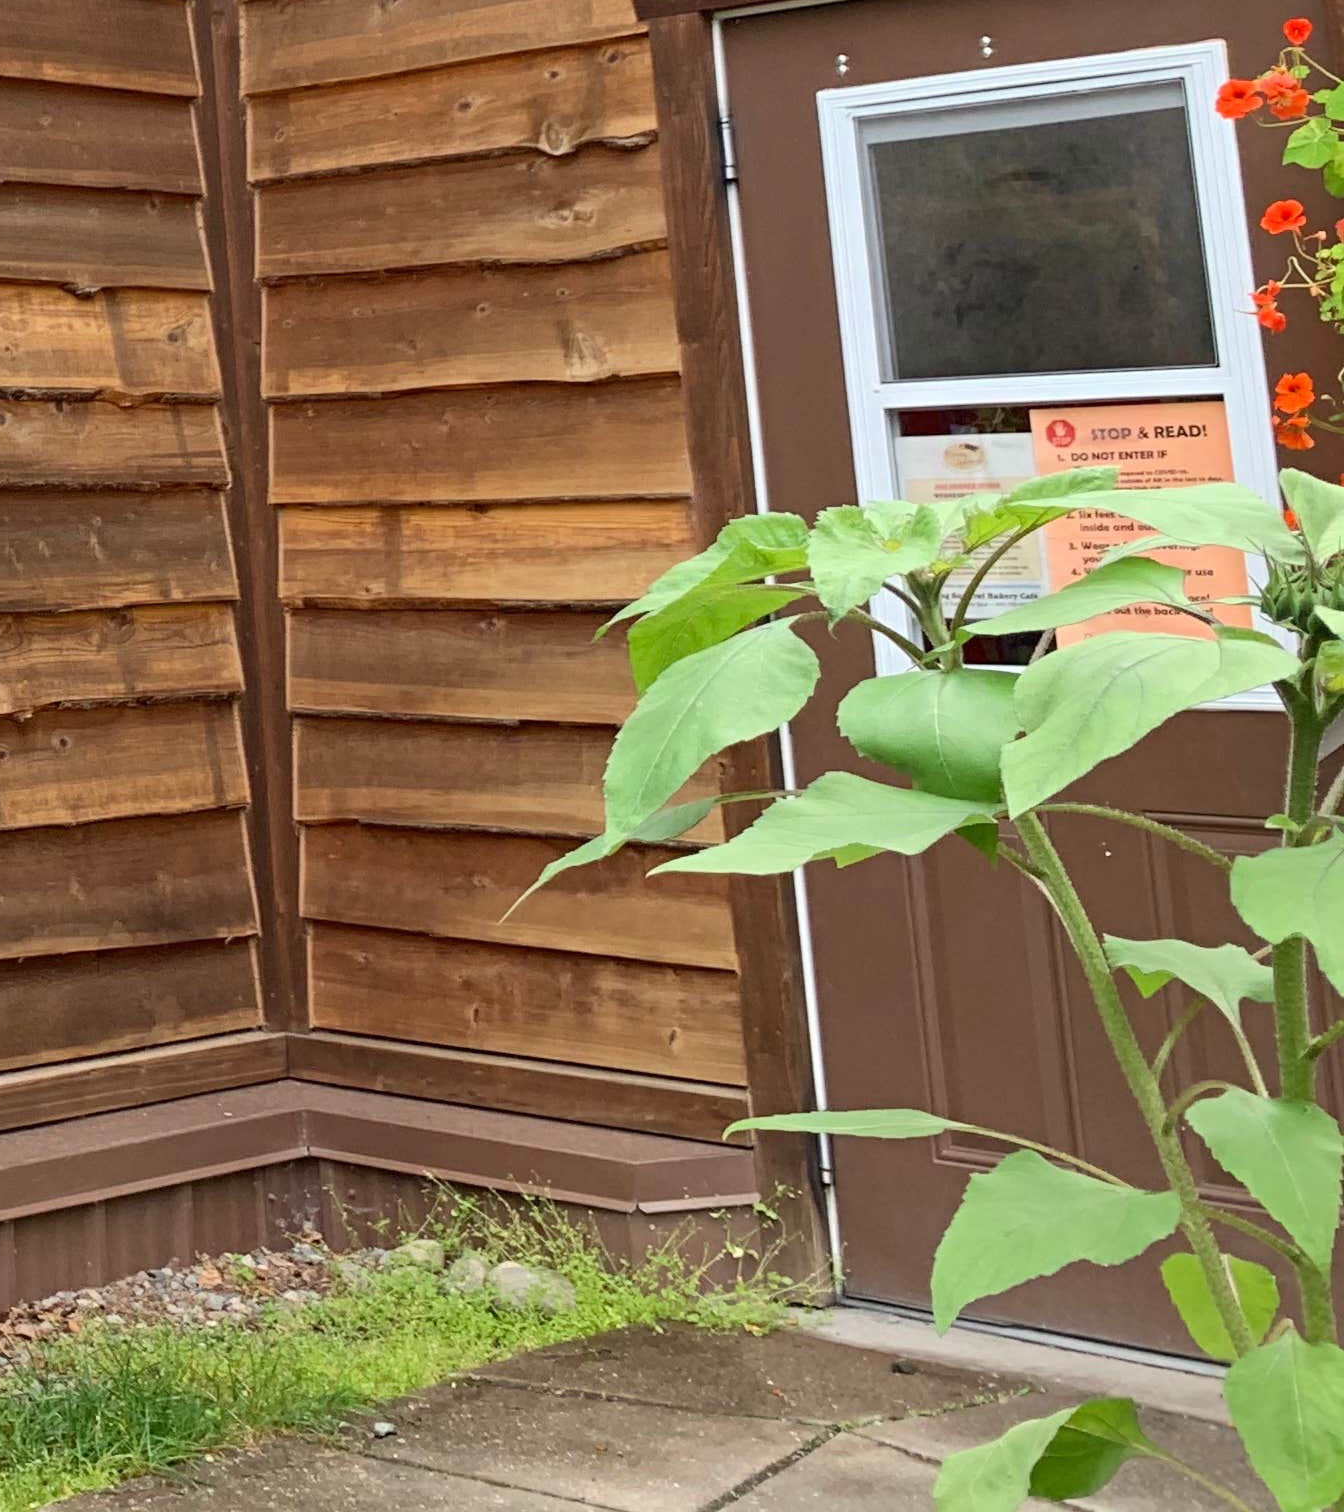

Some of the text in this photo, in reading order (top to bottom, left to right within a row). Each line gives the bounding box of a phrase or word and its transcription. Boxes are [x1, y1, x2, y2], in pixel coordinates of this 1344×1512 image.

[1090, 424, 1208, 440] STOP & READ!
[1070, 452, 1089, 461] DO
[1091, 451, 1115, 461] NOT
[1118, 450, 1154, 460] ENTER
[1157, 449, 1168, 459] IF
[1079, 523, 1110, 532] inside
[1112, 522, 1134, 532] and
[1134, 606, 1151, 615] the
